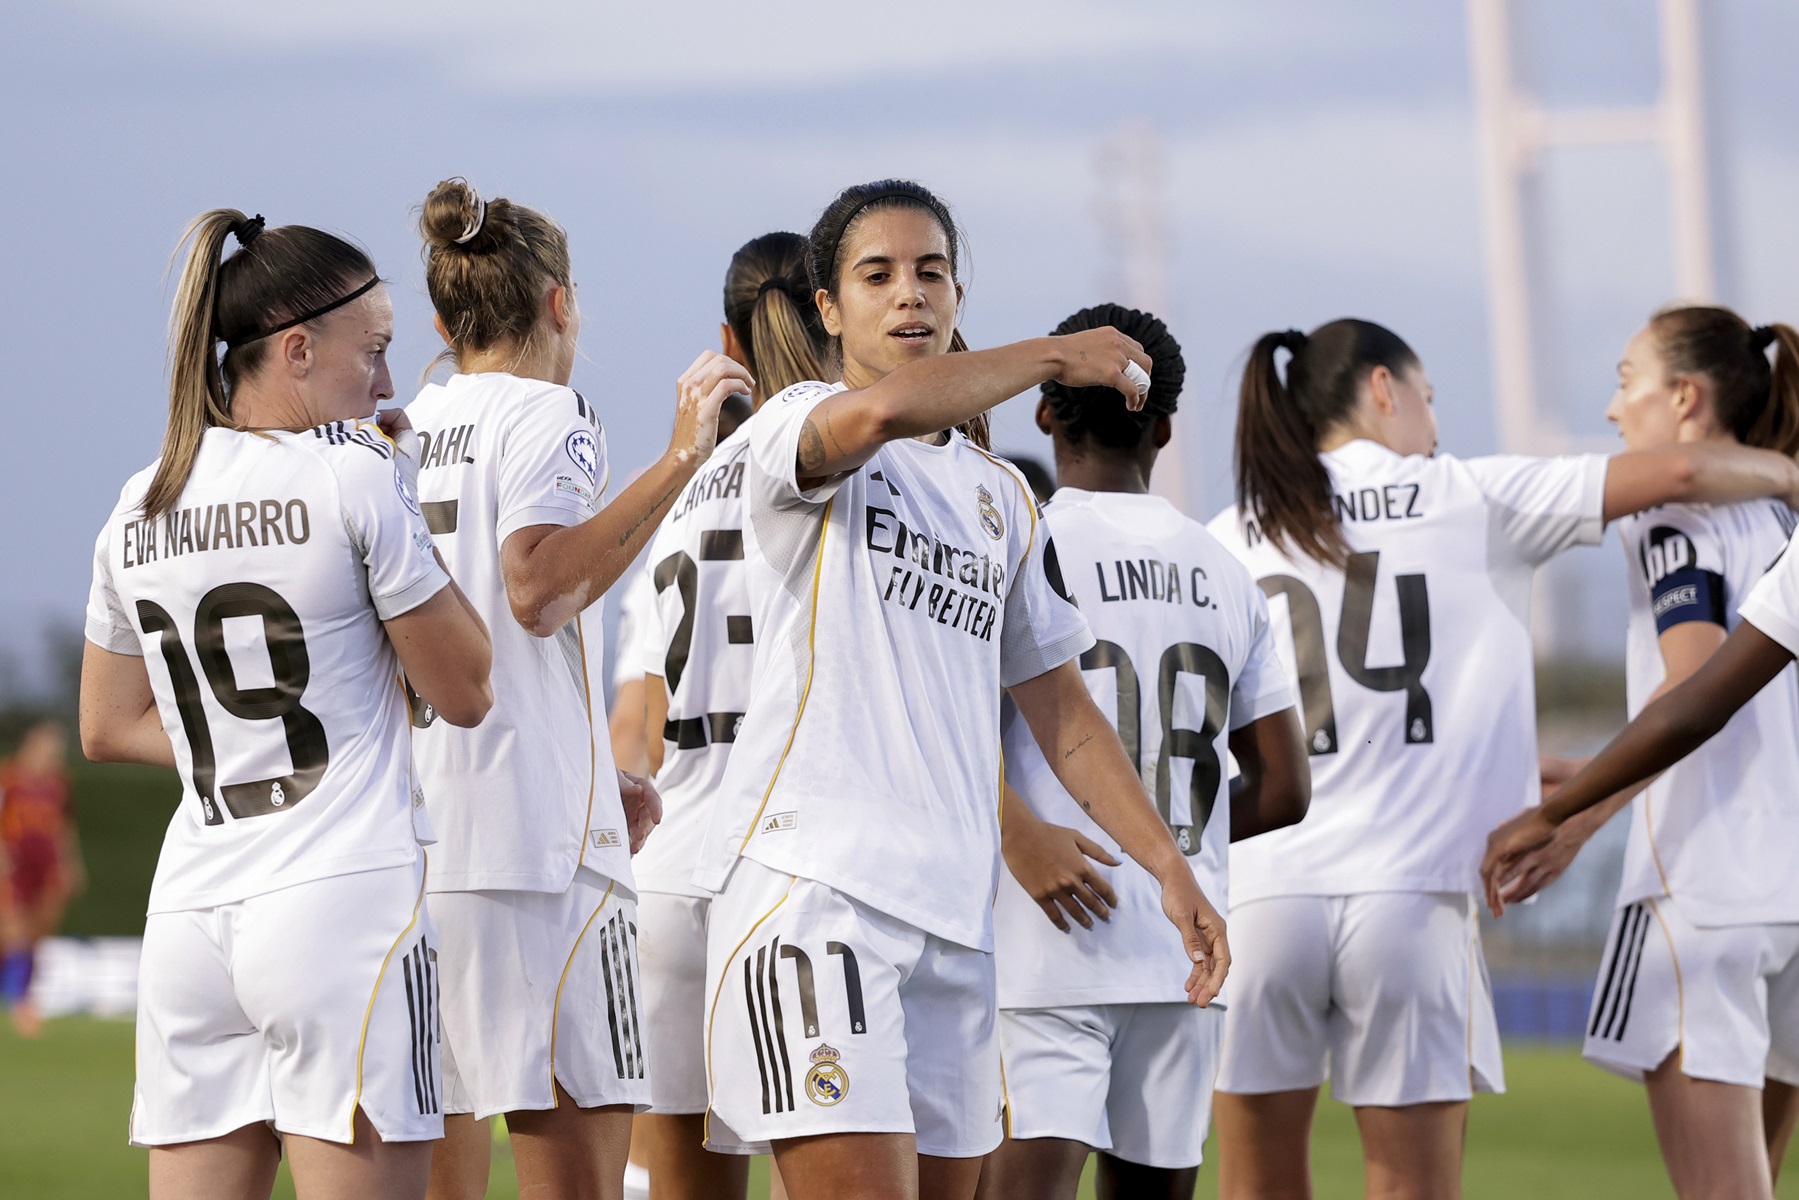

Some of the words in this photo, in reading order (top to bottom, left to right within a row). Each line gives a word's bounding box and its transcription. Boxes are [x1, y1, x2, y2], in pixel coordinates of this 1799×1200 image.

[122, 513, 158, 569] EVA
[164, 498, 310, 558] NAVARRO
[1246, 484, 1424, 549] MNDEZ
[866, 505, 1006, 604] Emirate
[1095, 558, 1182, 604] LINDA
[1190, 566, 1218, 610] C.
[883, 566, 926, 611] FLY
[927, 583, 998, 642] BETTER
[135, 582, 329, 826] 19
